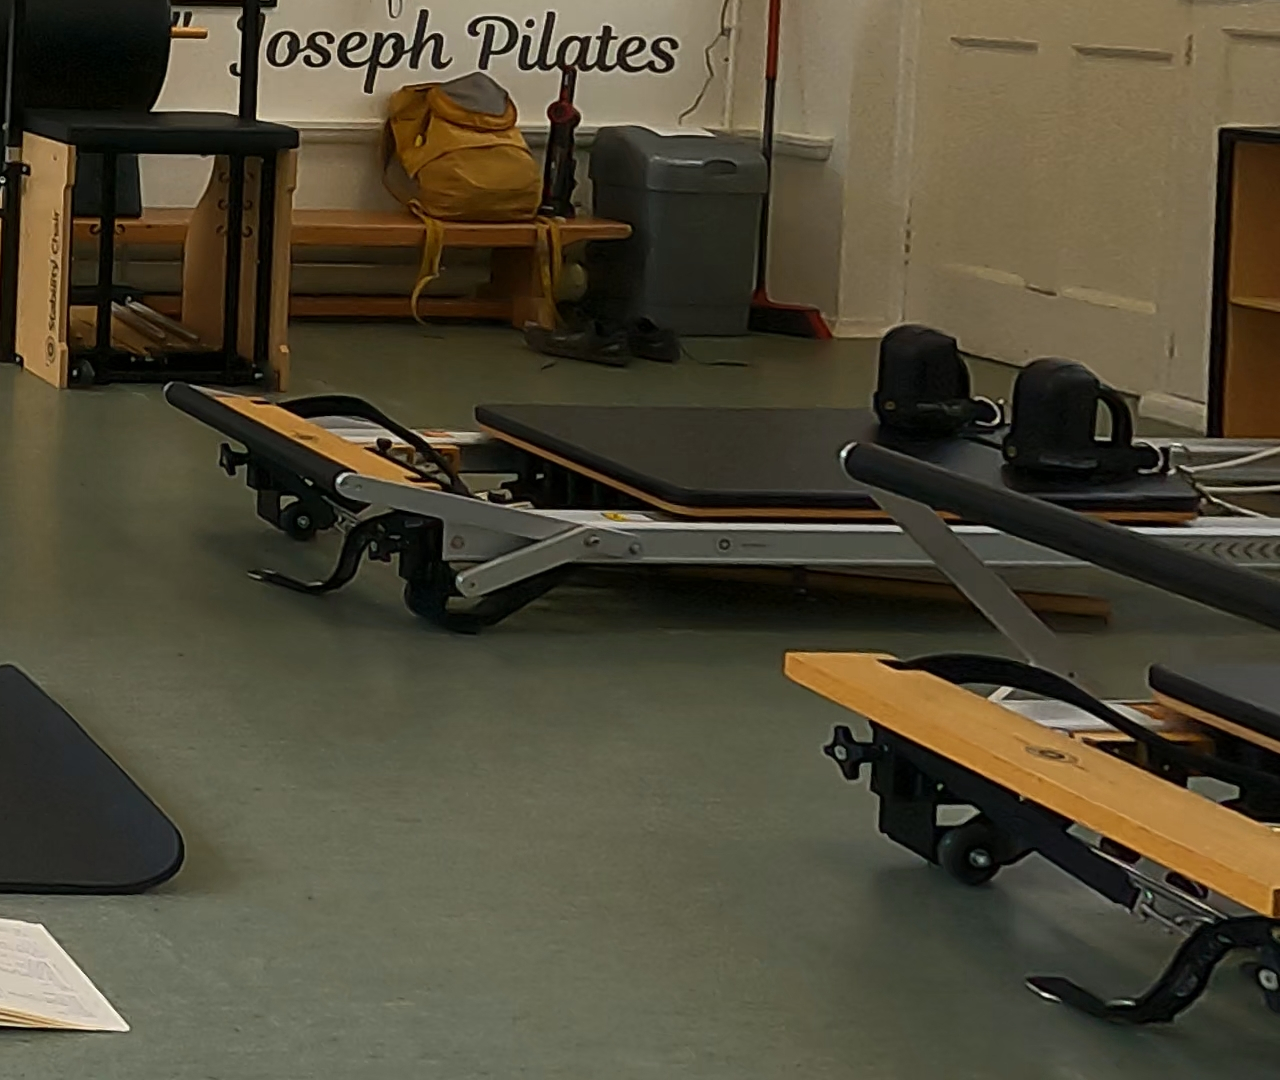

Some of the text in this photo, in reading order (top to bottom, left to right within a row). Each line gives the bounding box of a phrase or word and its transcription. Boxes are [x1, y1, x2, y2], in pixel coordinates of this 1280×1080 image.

[467, 10, 680, 73] Pilates
[48, 209, 61, 331] Stability Chair
